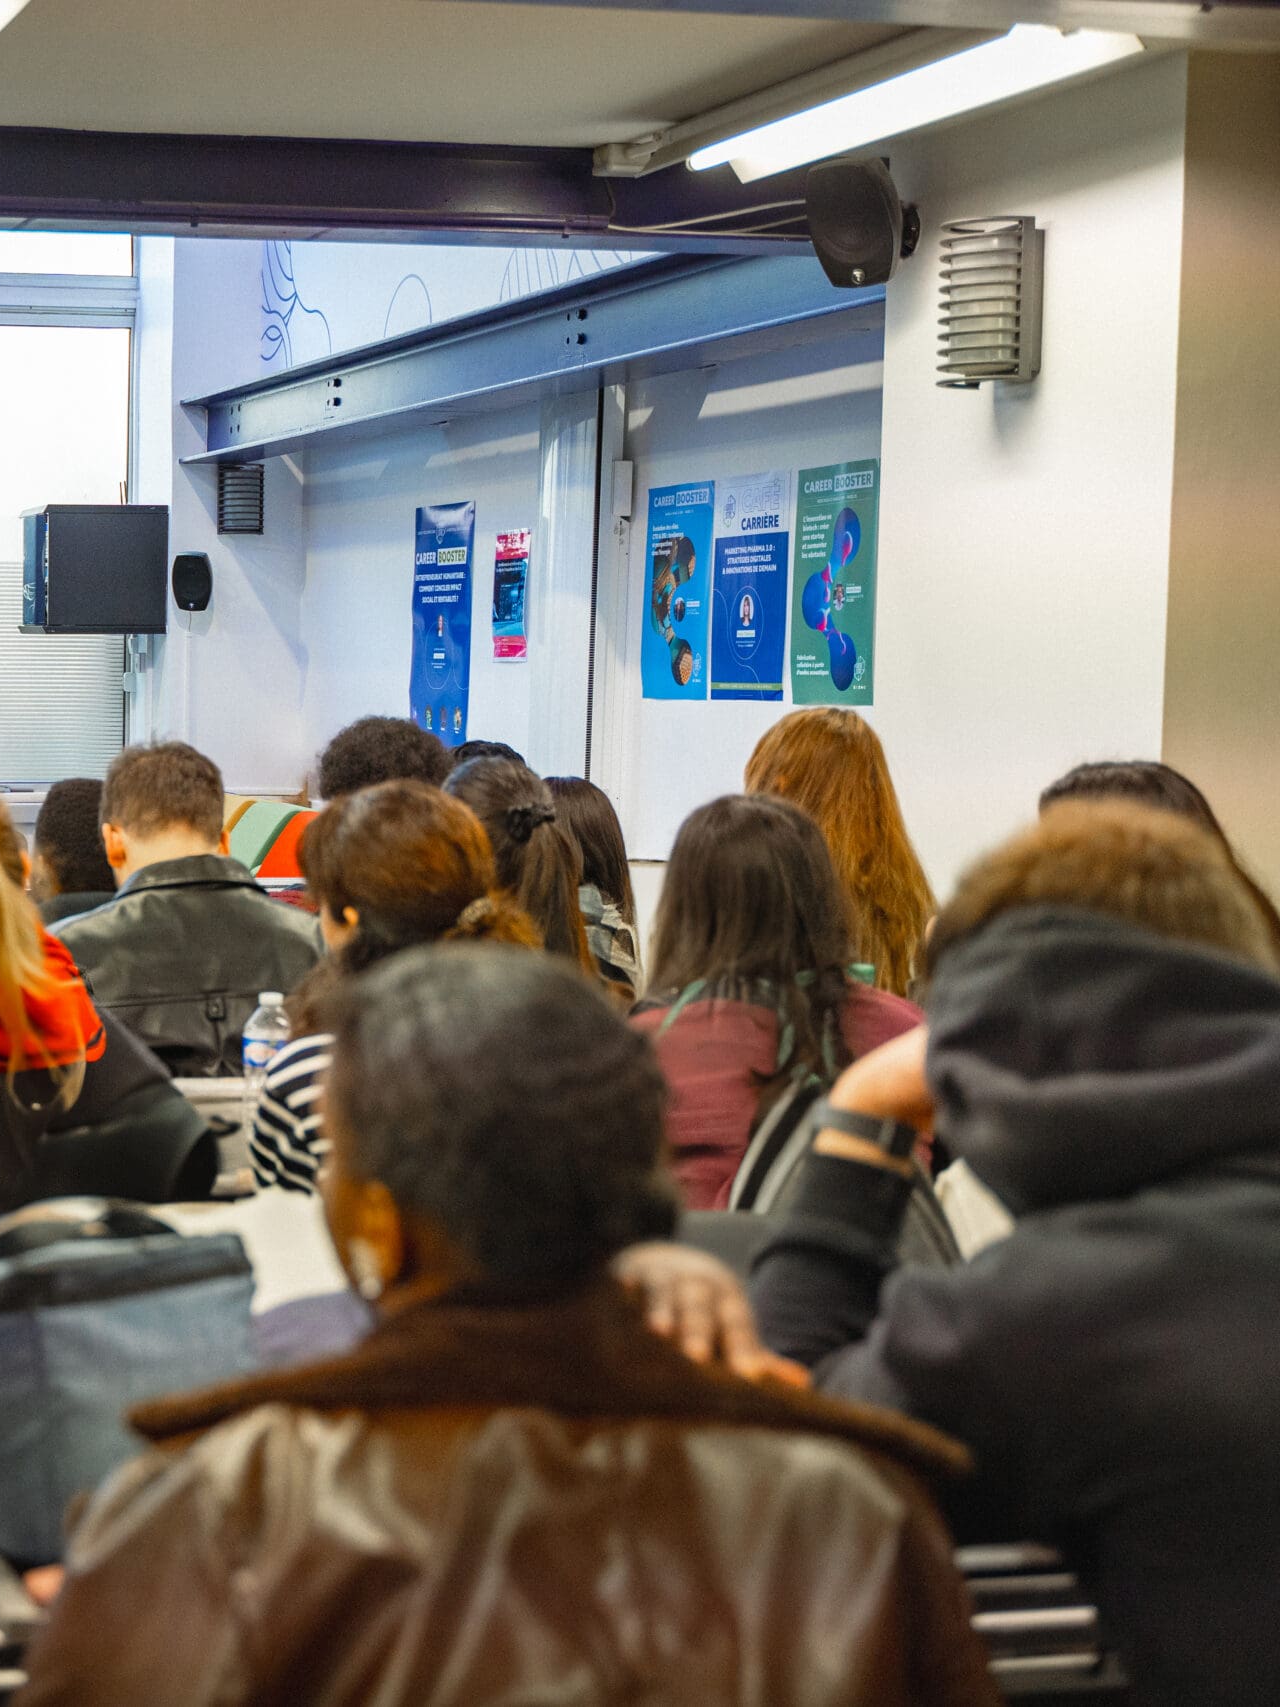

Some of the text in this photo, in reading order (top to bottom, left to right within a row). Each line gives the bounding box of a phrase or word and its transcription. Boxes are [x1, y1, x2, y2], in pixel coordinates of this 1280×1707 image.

[804, 473, 872, 493] CAREER BOOSTER
[654, 490, 708, 507] CAREER BOOSTER
[741, 512, 780, 530] CARRIÈRE
[416, 549, 465, 565] CAREER BOOSTER
